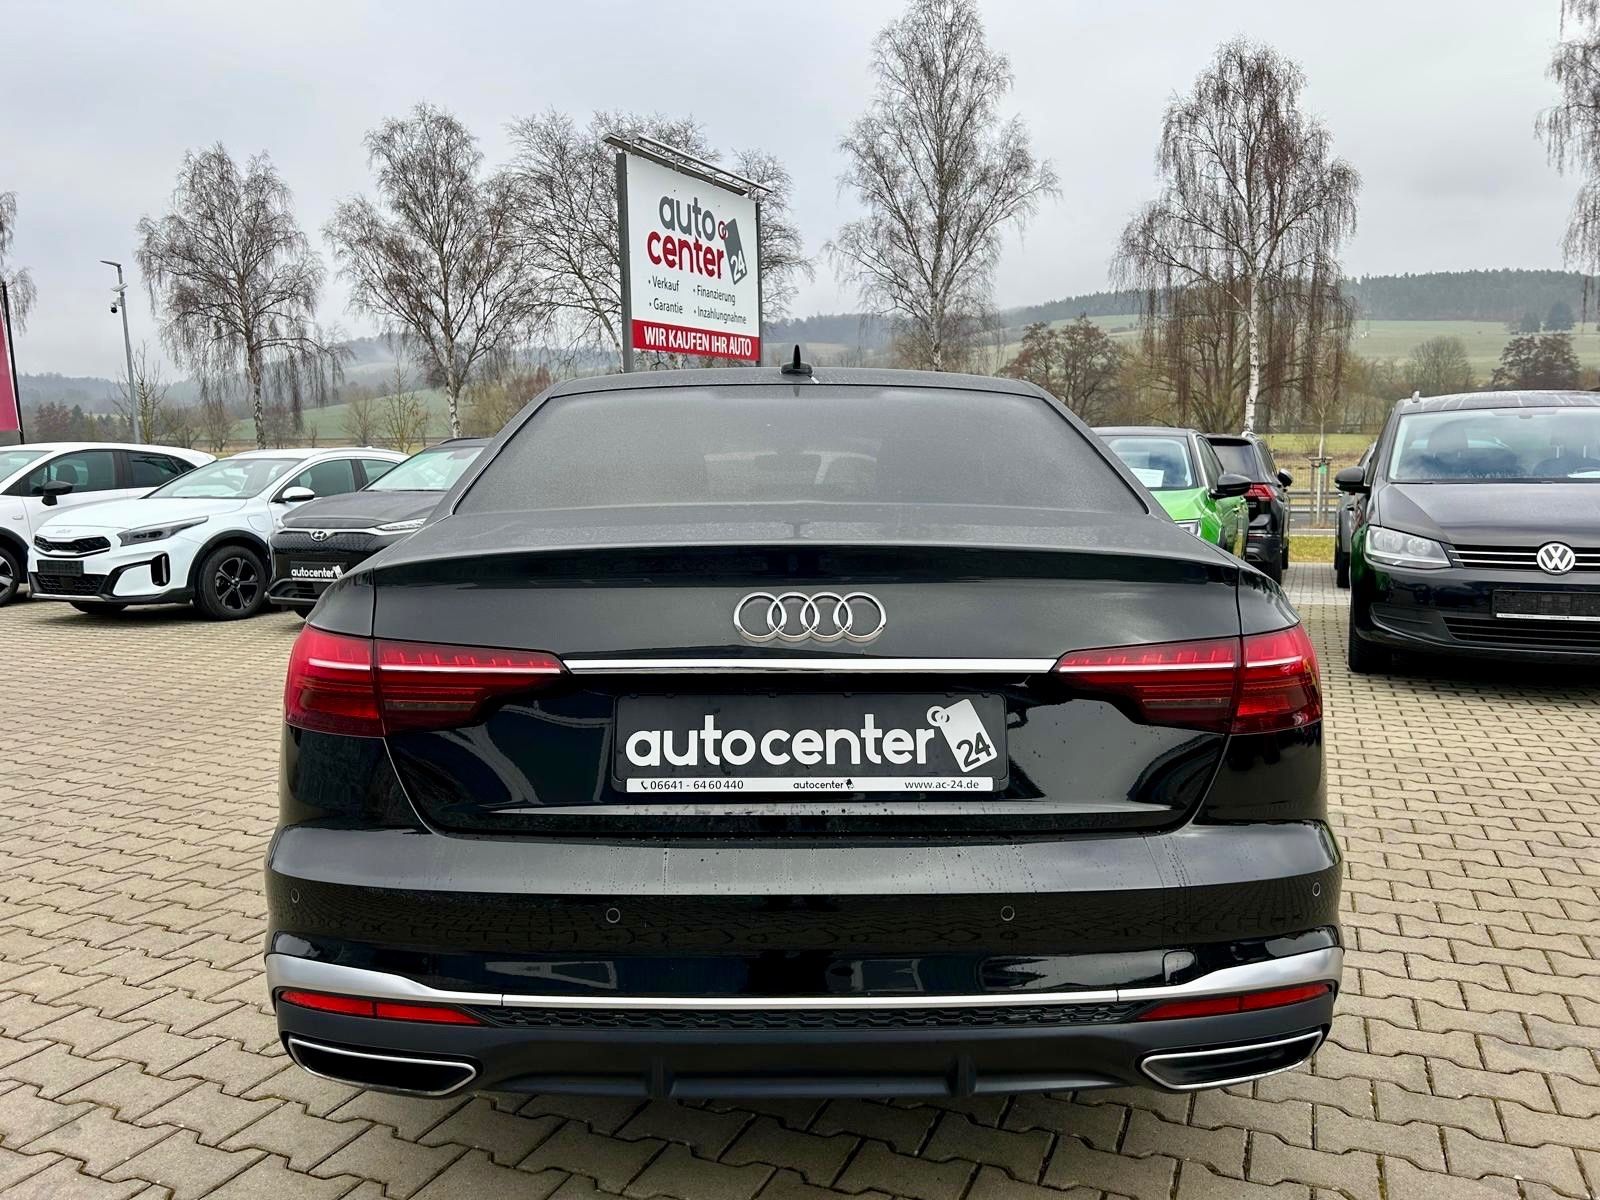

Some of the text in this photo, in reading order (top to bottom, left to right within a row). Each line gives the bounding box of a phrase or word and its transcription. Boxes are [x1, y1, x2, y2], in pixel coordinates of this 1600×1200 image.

[659, 195, 716, 242] auto
[647, 231, 724, 279] center
[730, 250, 746, 281] 24
[652, 276, 680, 292] Verkauf
[696, 285, 736, 306] Finanzierung
[653, 298, 683, 314] Garantie
[697, 306, 747, 325] Inzahlungnahme
[644, 325, 752, 356] WIR KAUFEN IHR AUTO
[956, 732, 992, 768] 24
[650, 780, 683, 790] 06641
[793, 780, 844, 790] autocenter
[904, 779, 979, 790] www.ac-24.de
